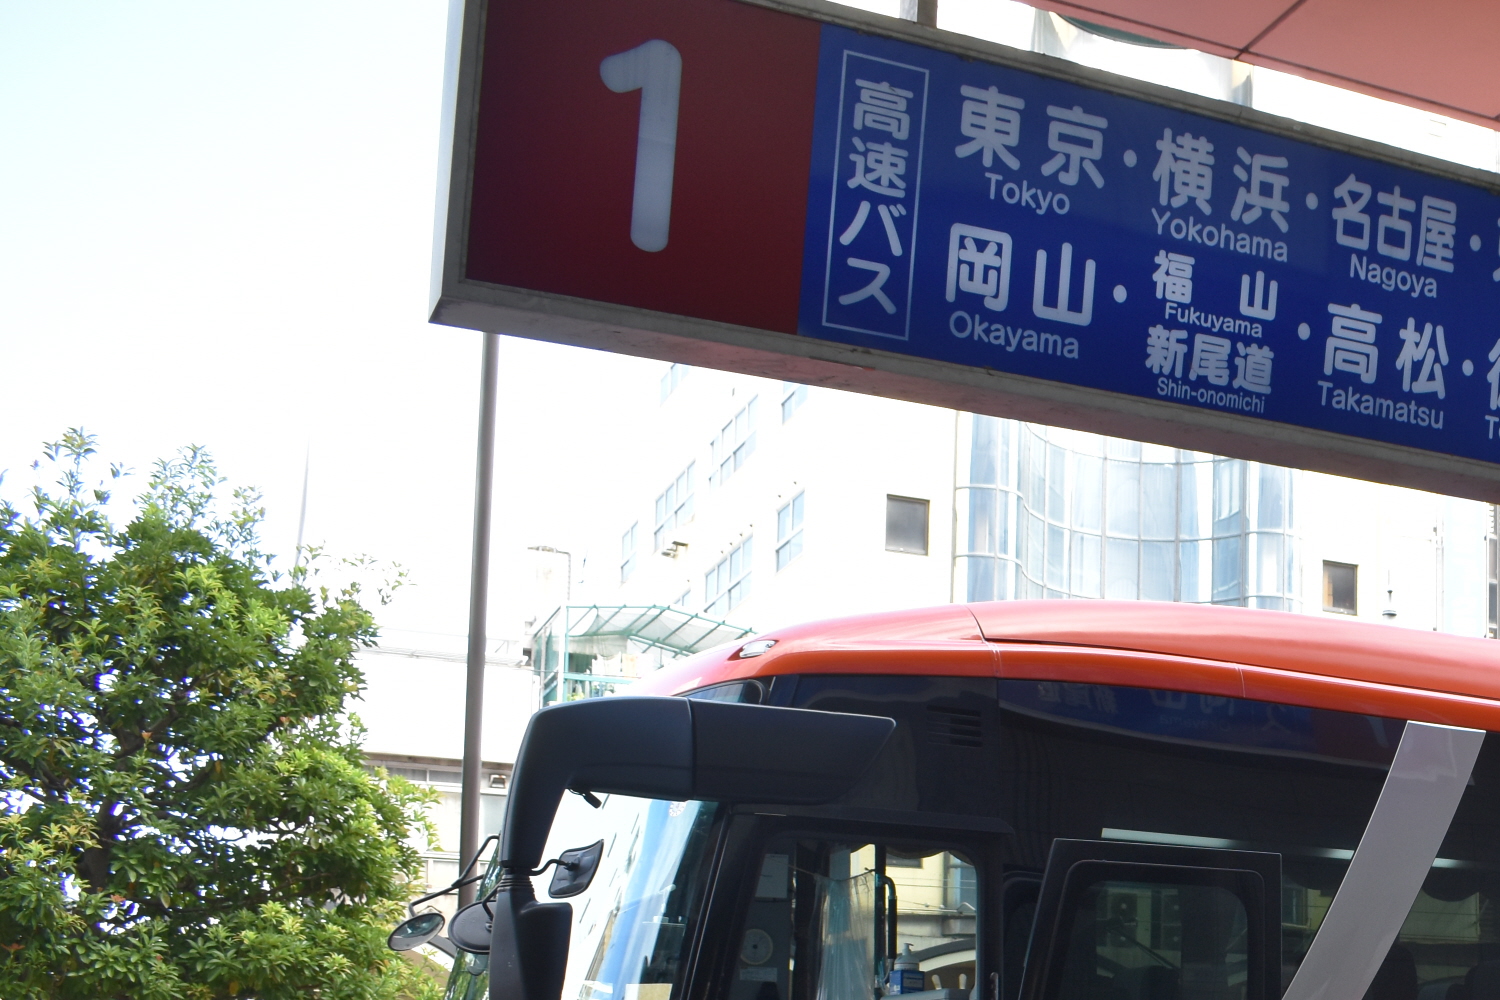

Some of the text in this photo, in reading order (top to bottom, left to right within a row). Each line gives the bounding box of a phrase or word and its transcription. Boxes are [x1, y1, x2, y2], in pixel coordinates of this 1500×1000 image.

[600, 38, 683, 253] 1
[838, 76, 916, 316] 高速バス
[984, 172, 1072, 217] Tokyo
[1151, 208, 1290, 263] Yokohama
[1350, 253, 1438, 300] Nagoya
[948, 311, 1080, 360] Okayama
[1164, 302, 1264, 339] Fukuyama
[1317, 381, 1444, 430] Takamatsu
[1145, 325, 1274, 395] 新尾道
[1156, 376, 1266, 414] Shin-onomichi
